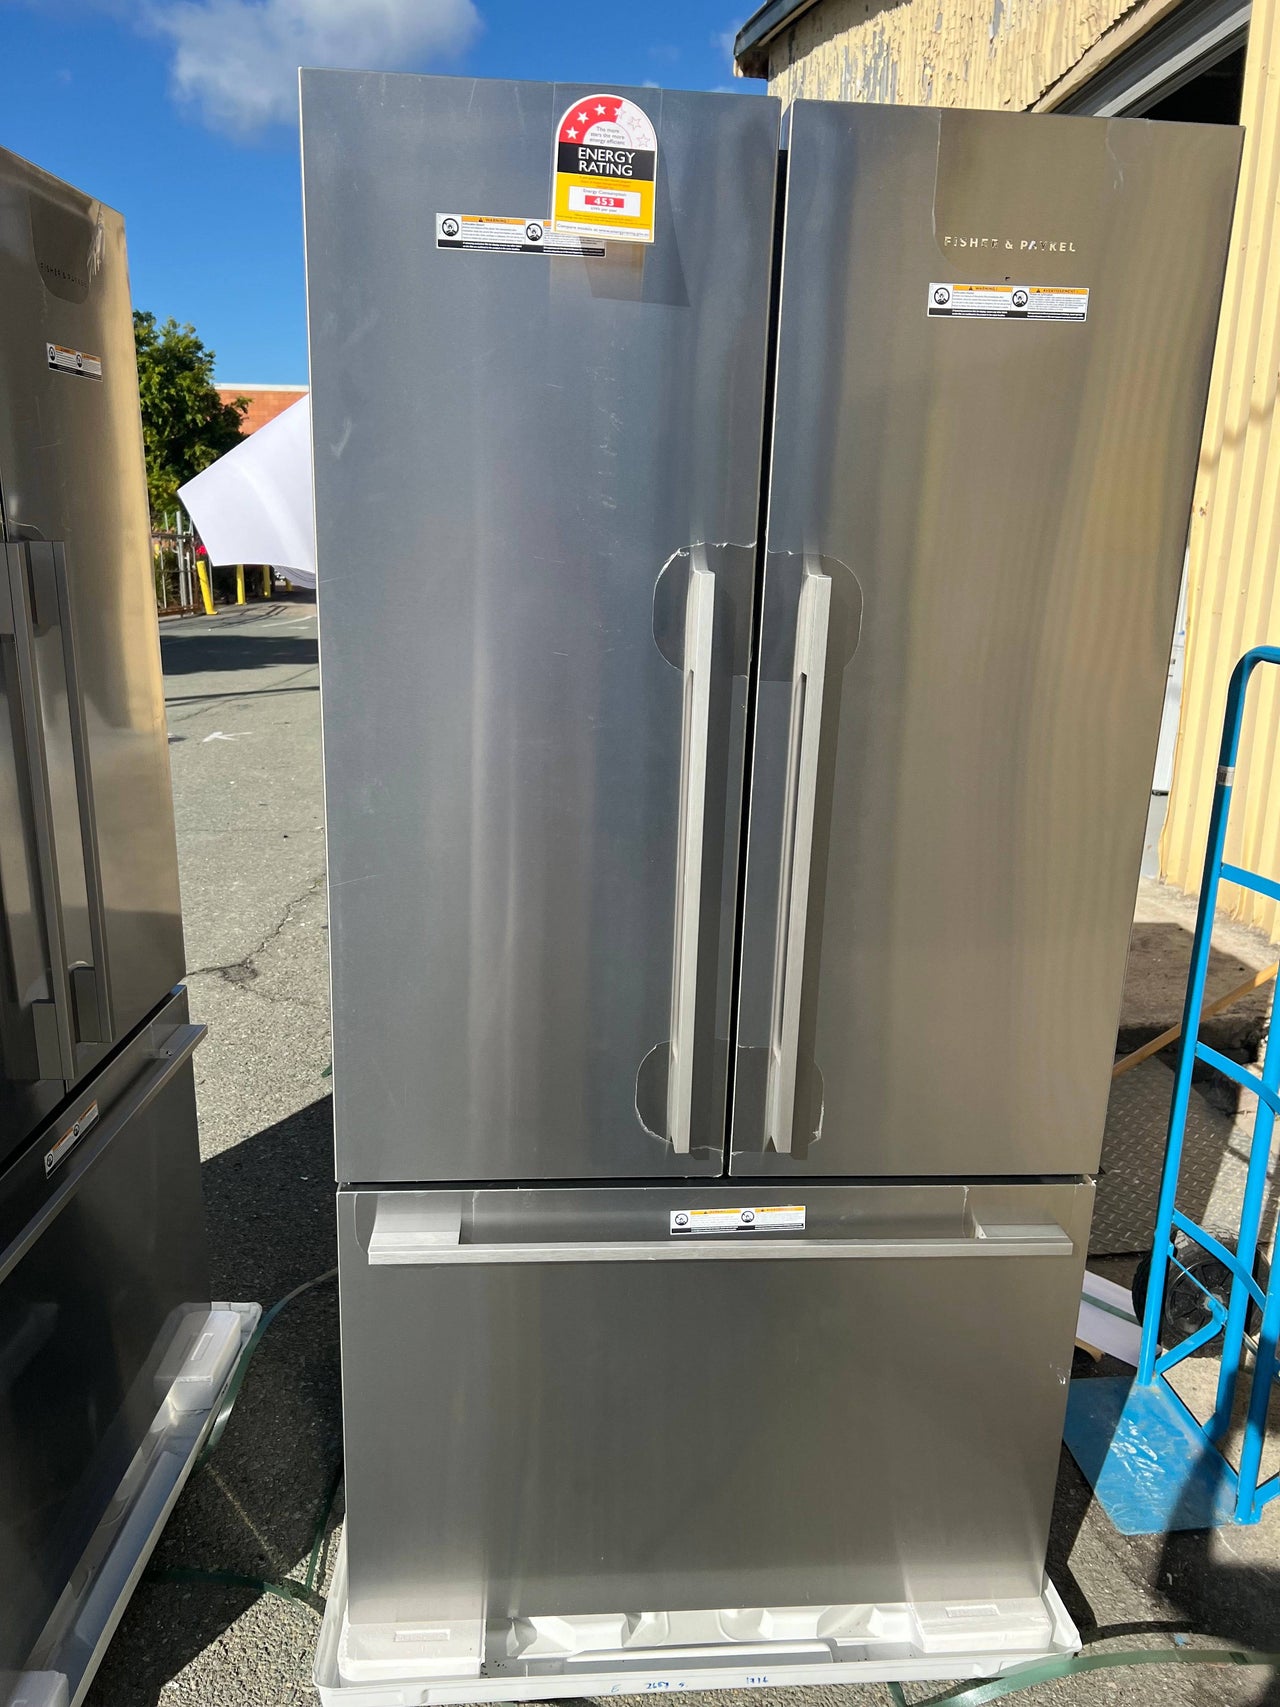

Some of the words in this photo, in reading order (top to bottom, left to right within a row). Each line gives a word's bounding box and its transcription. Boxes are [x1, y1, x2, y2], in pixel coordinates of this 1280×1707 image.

[578, 147, 635, 164] ENERGY
[579, 161, 633, 176] RATING
[594, 198, 614, 206] 453
[1005, 240, 1014, 250] &
[1020, 240, 1076, 252] PAYKEL
